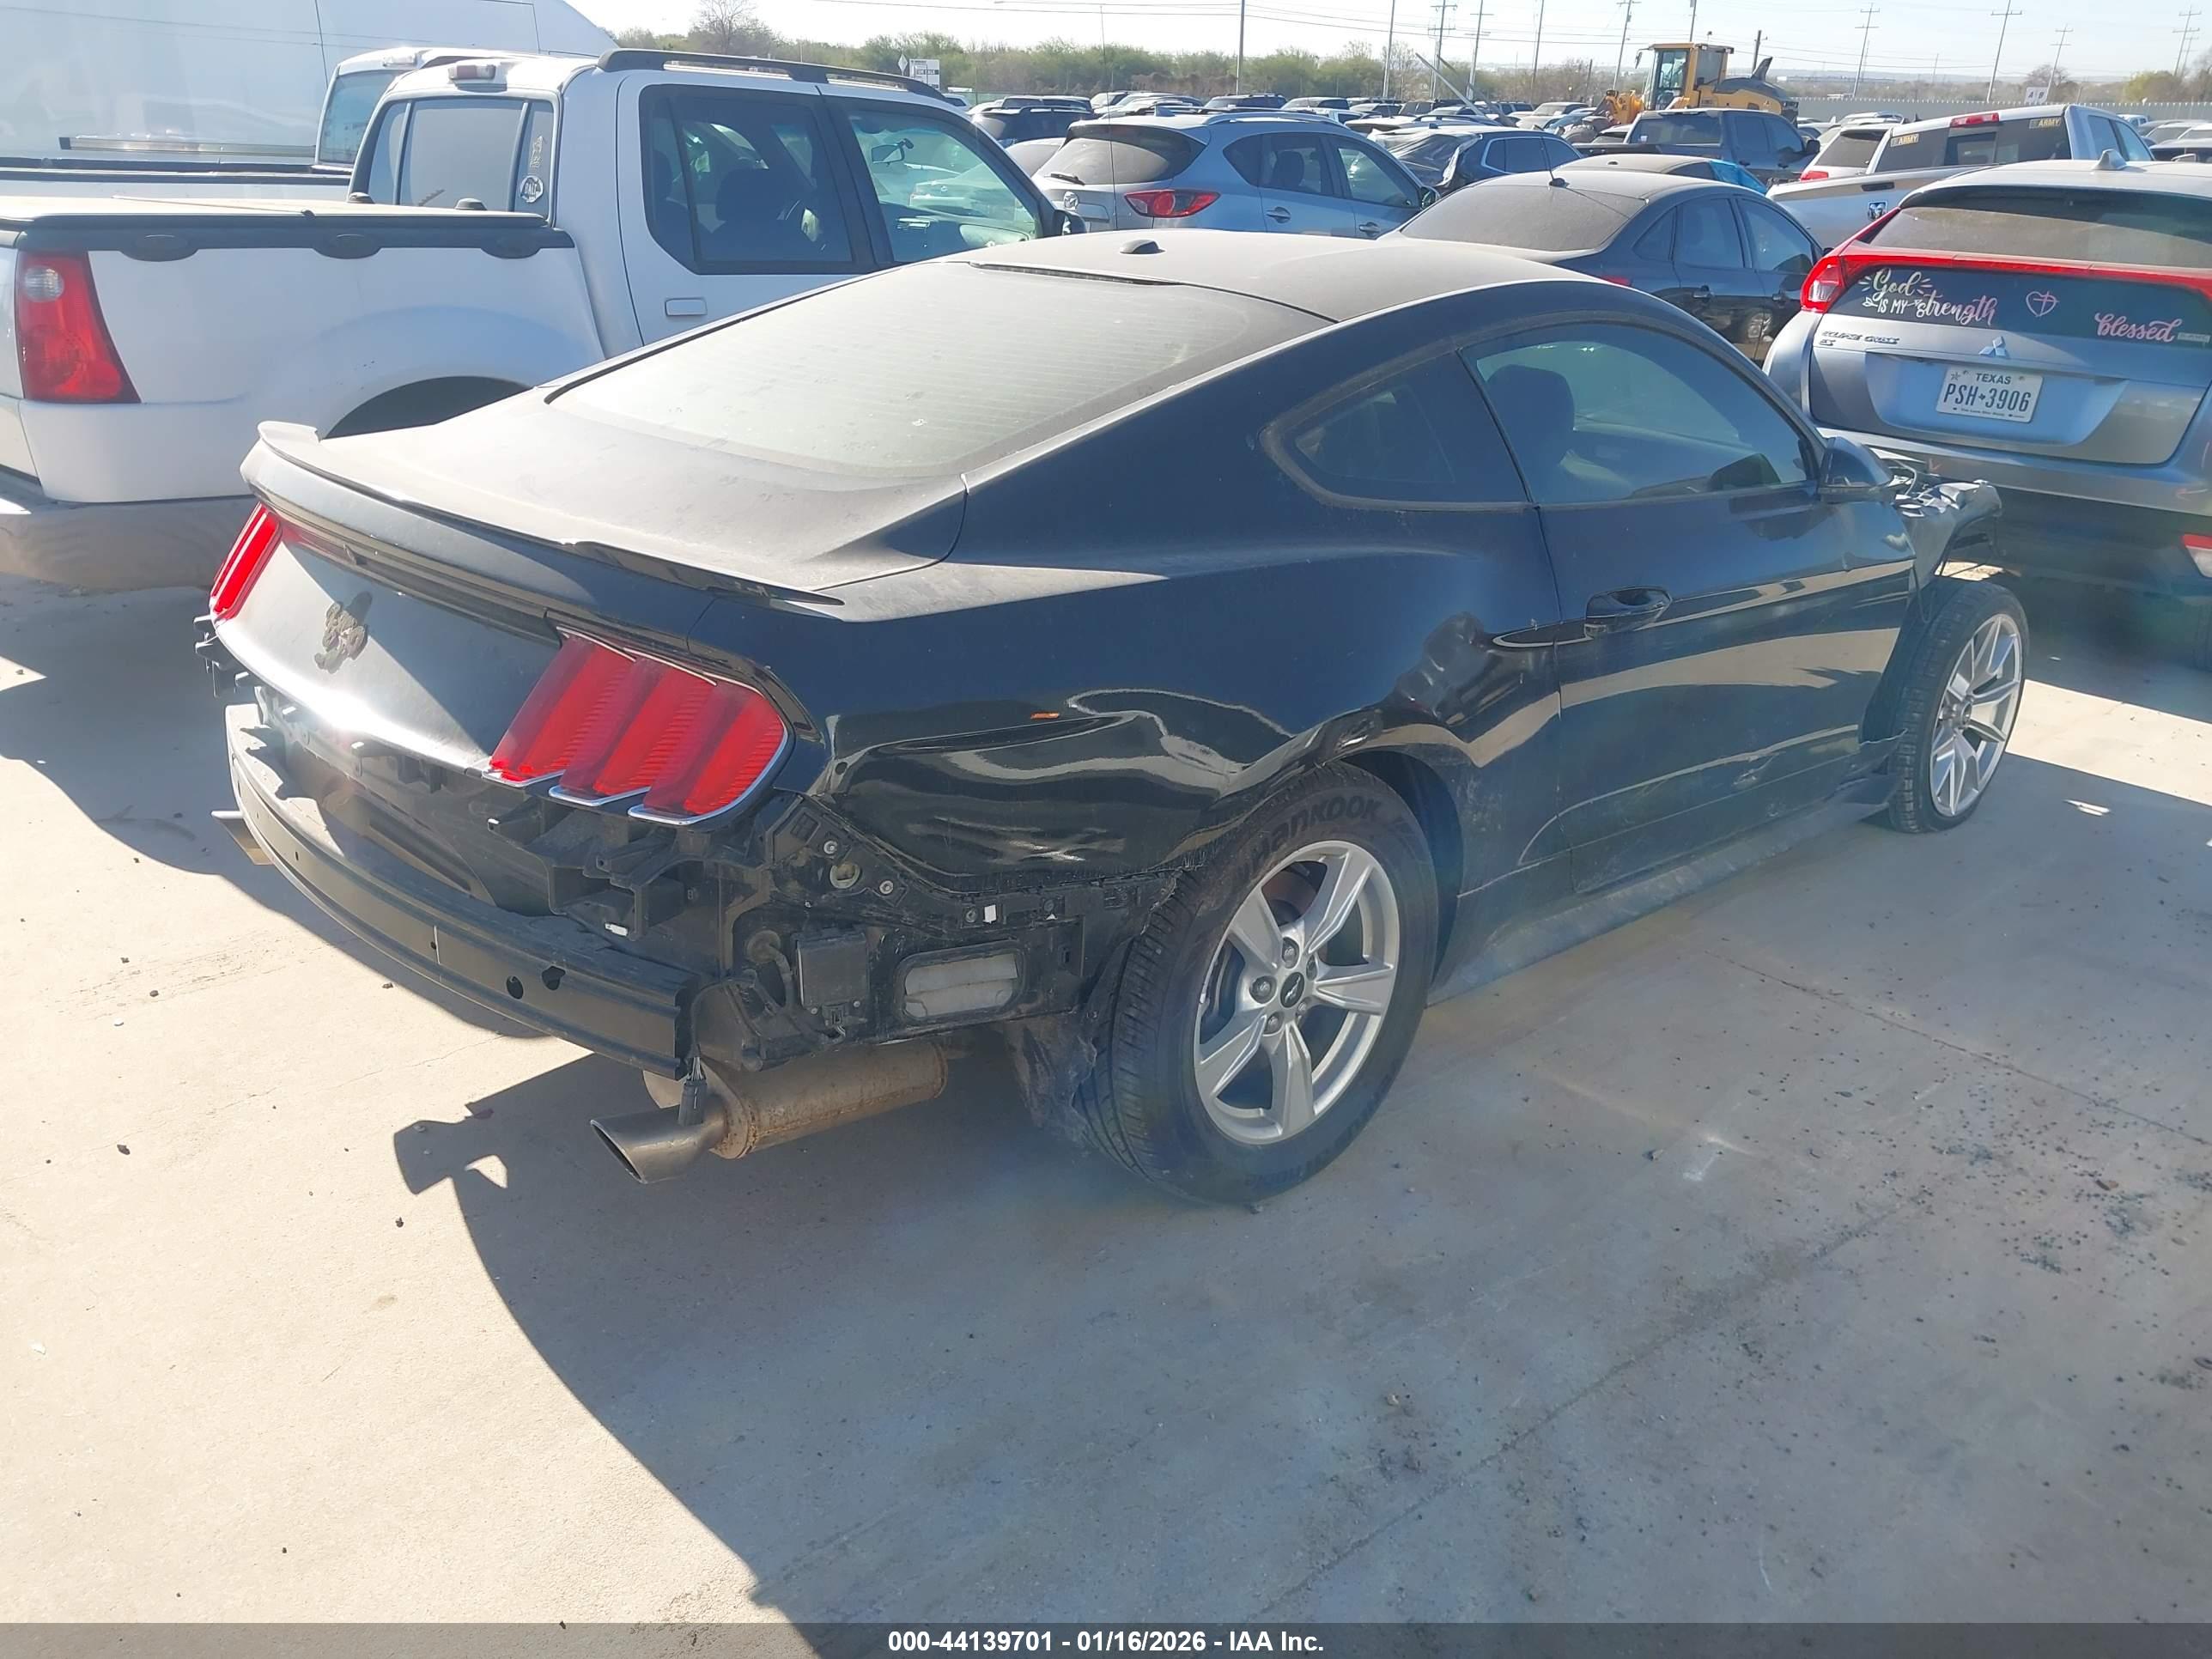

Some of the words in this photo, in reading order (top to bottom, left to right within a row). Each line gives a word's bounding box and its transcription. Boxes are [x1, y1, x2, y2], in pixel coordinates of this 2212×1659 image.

[2038, 118, 2061, 128] ARMY
[1898, 134, 1918, 145] ARMY
[1872, 268, 1923, 301] God
[1877, 298, 1889, 313] IS
[1890, 299, 1908, 314] MY
[1916, 289, 1998, 326] strength
[2094, 312, 2183, 342] blessed
[1976, 372, 2012, 385] TEXAS
